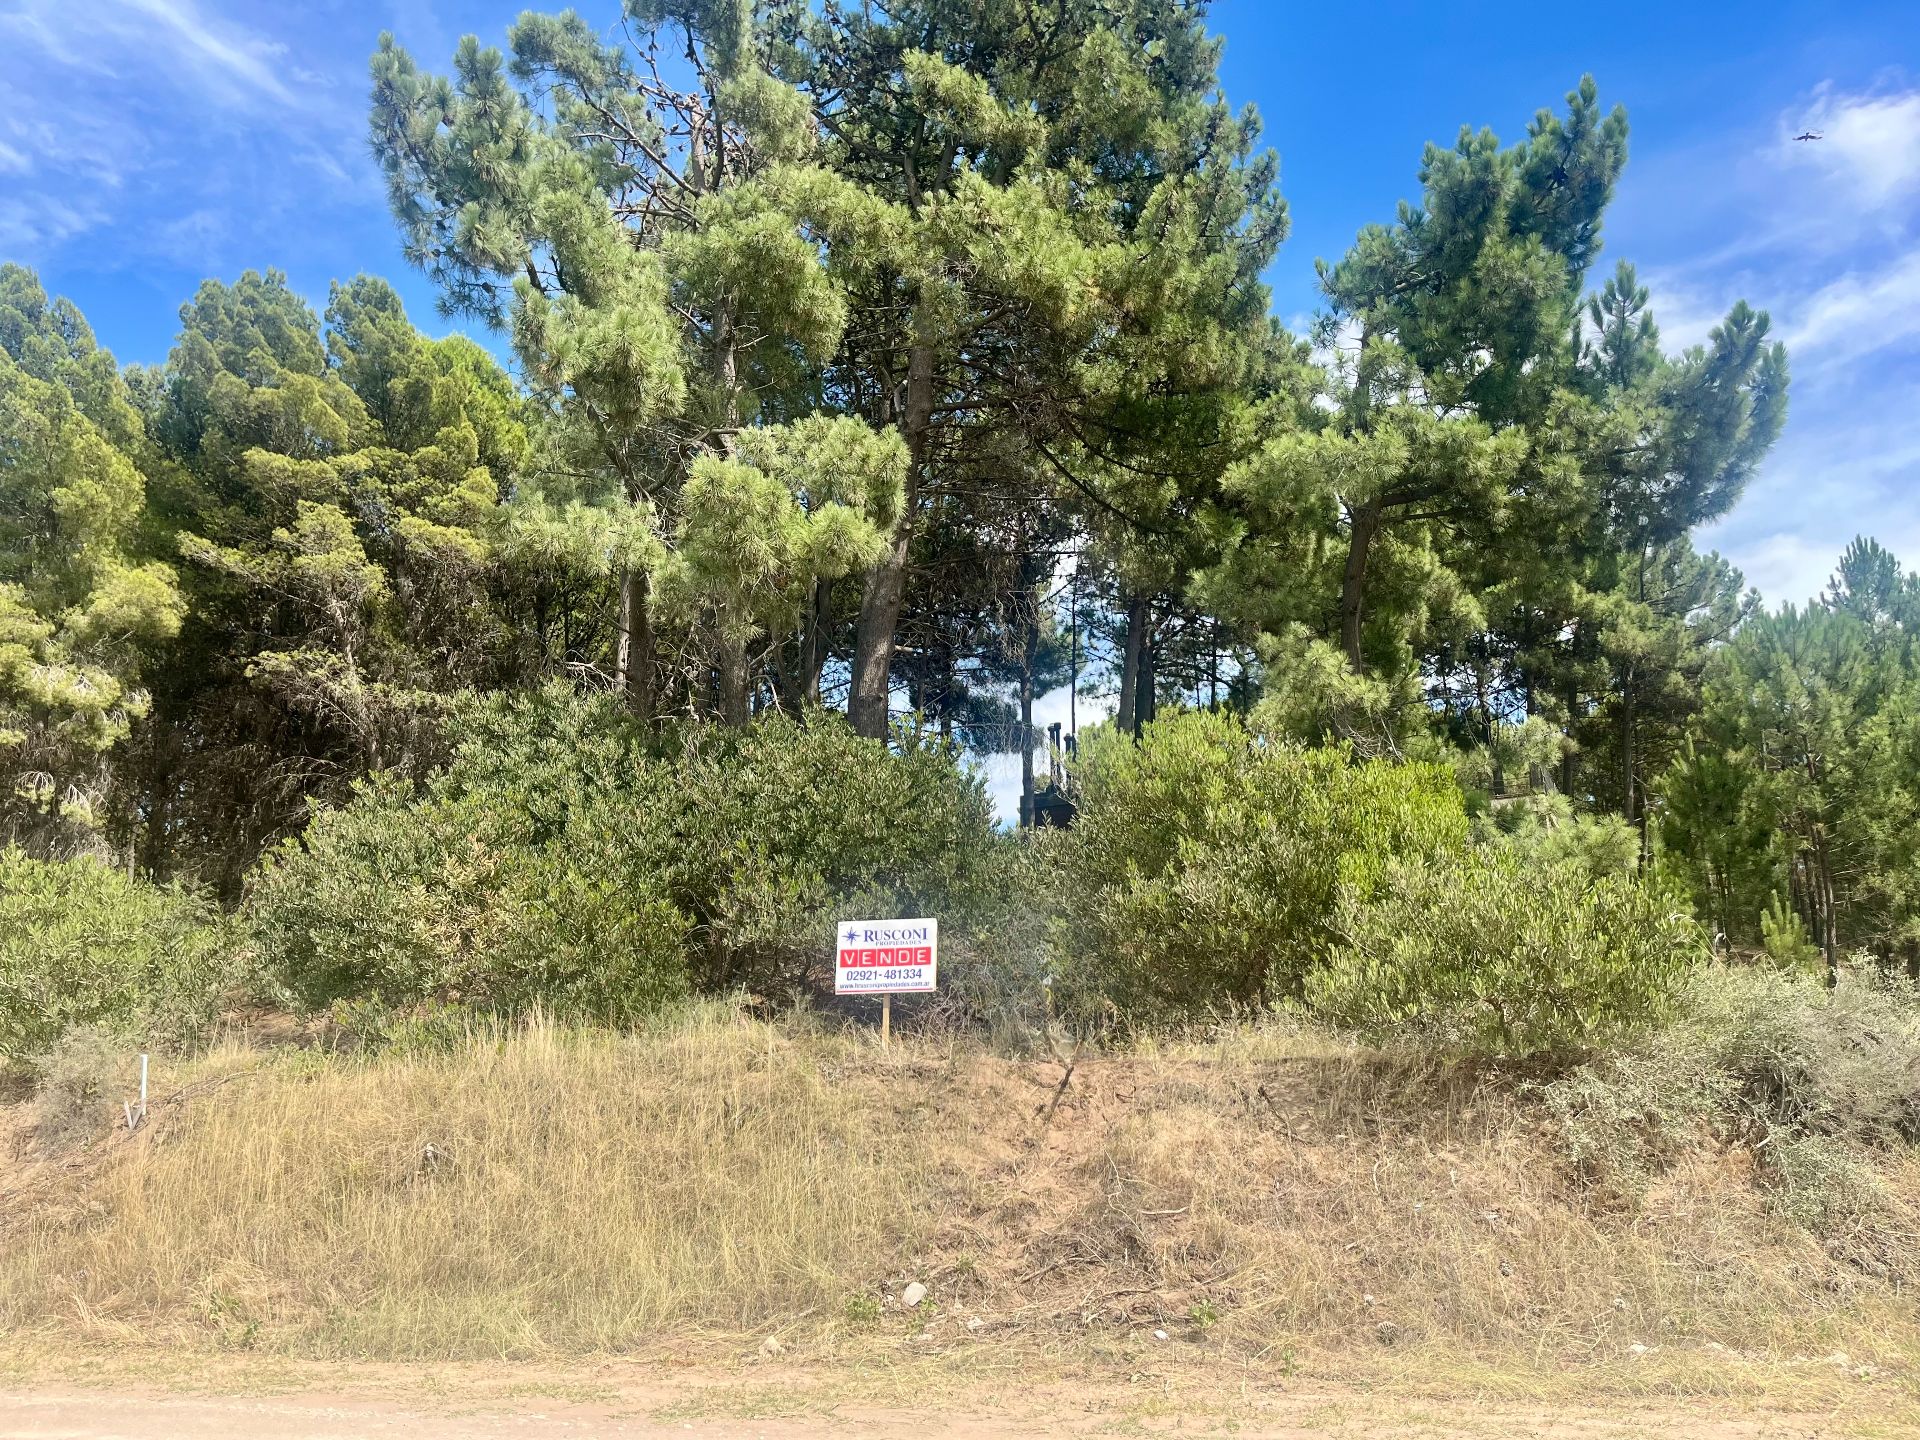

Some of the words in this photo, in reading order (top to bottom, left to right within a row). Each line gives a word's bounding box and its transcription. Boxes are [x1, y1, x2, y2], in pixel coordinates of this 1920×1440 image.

[864, 928, 928, 942] RUSCONI
[844, 950, 926, 965] VENDE
[846, 969, 922, 981] 02921-481334
